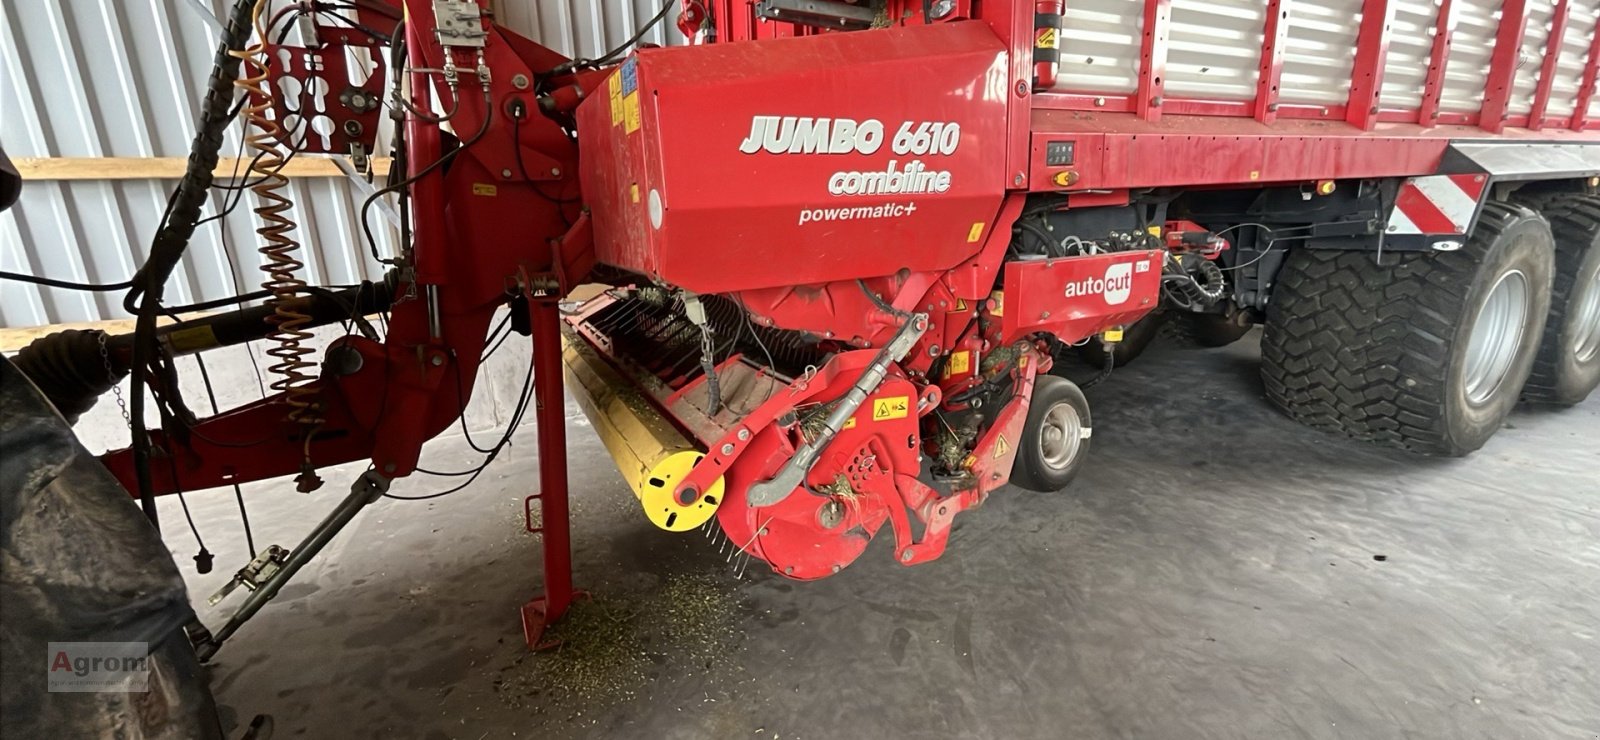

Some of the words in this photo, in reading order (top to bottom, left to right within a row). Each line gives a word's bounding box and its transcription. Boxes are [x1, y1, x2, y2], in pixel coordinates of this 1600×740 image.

[740, 116, 884, 154] JUMBO
[892, 121, 960, 155] 6610
[828, 160, 951, 194] combiline
[799, 202, 916, 225] powermatic+
